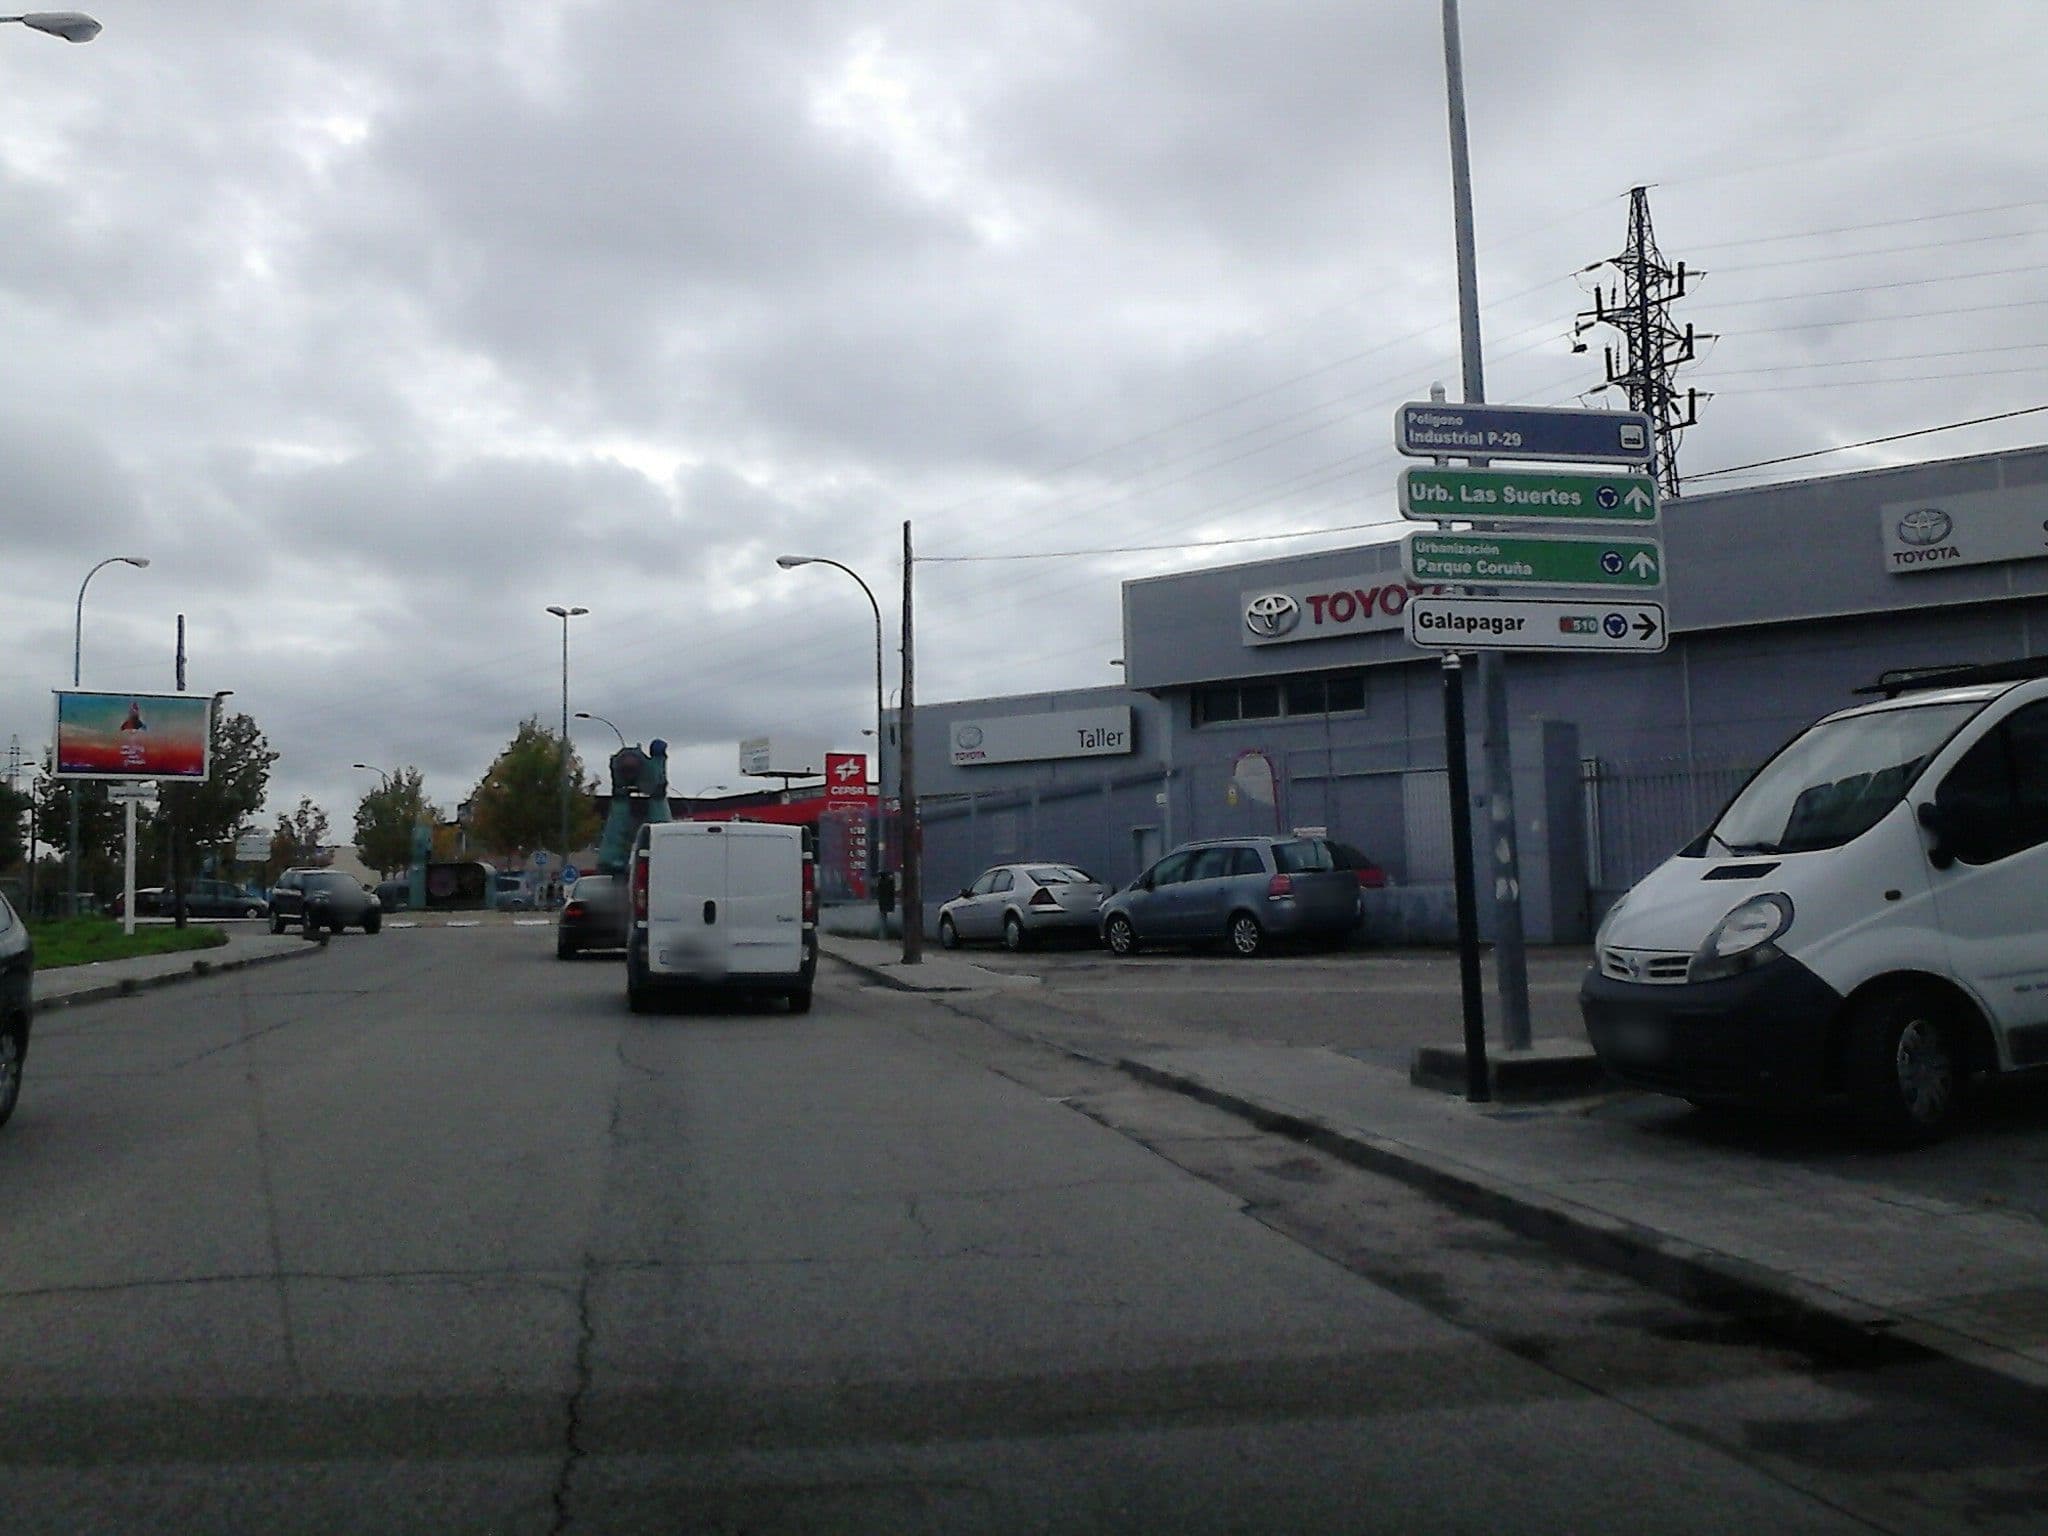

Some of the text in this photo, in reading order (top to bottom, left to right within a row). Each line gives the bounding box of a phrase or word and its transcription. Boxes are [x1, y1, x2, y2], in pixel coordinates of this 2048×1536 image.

[1409, 429, 1521, 447] Industrial P-29
[1411, 484, 1581, 506] Urb. Las Suertes
[1893, 546, 1960, 564] TOYOTA
[1416, 558, 1533, 576] Parque Coruña
[1306, 583, 1441, 624] TOYO
[1419, 612, 1525, 634] Galapagar
[1078, 727, 1124, 748] Taller
[955, 751, 986, 760] TOYOTA
